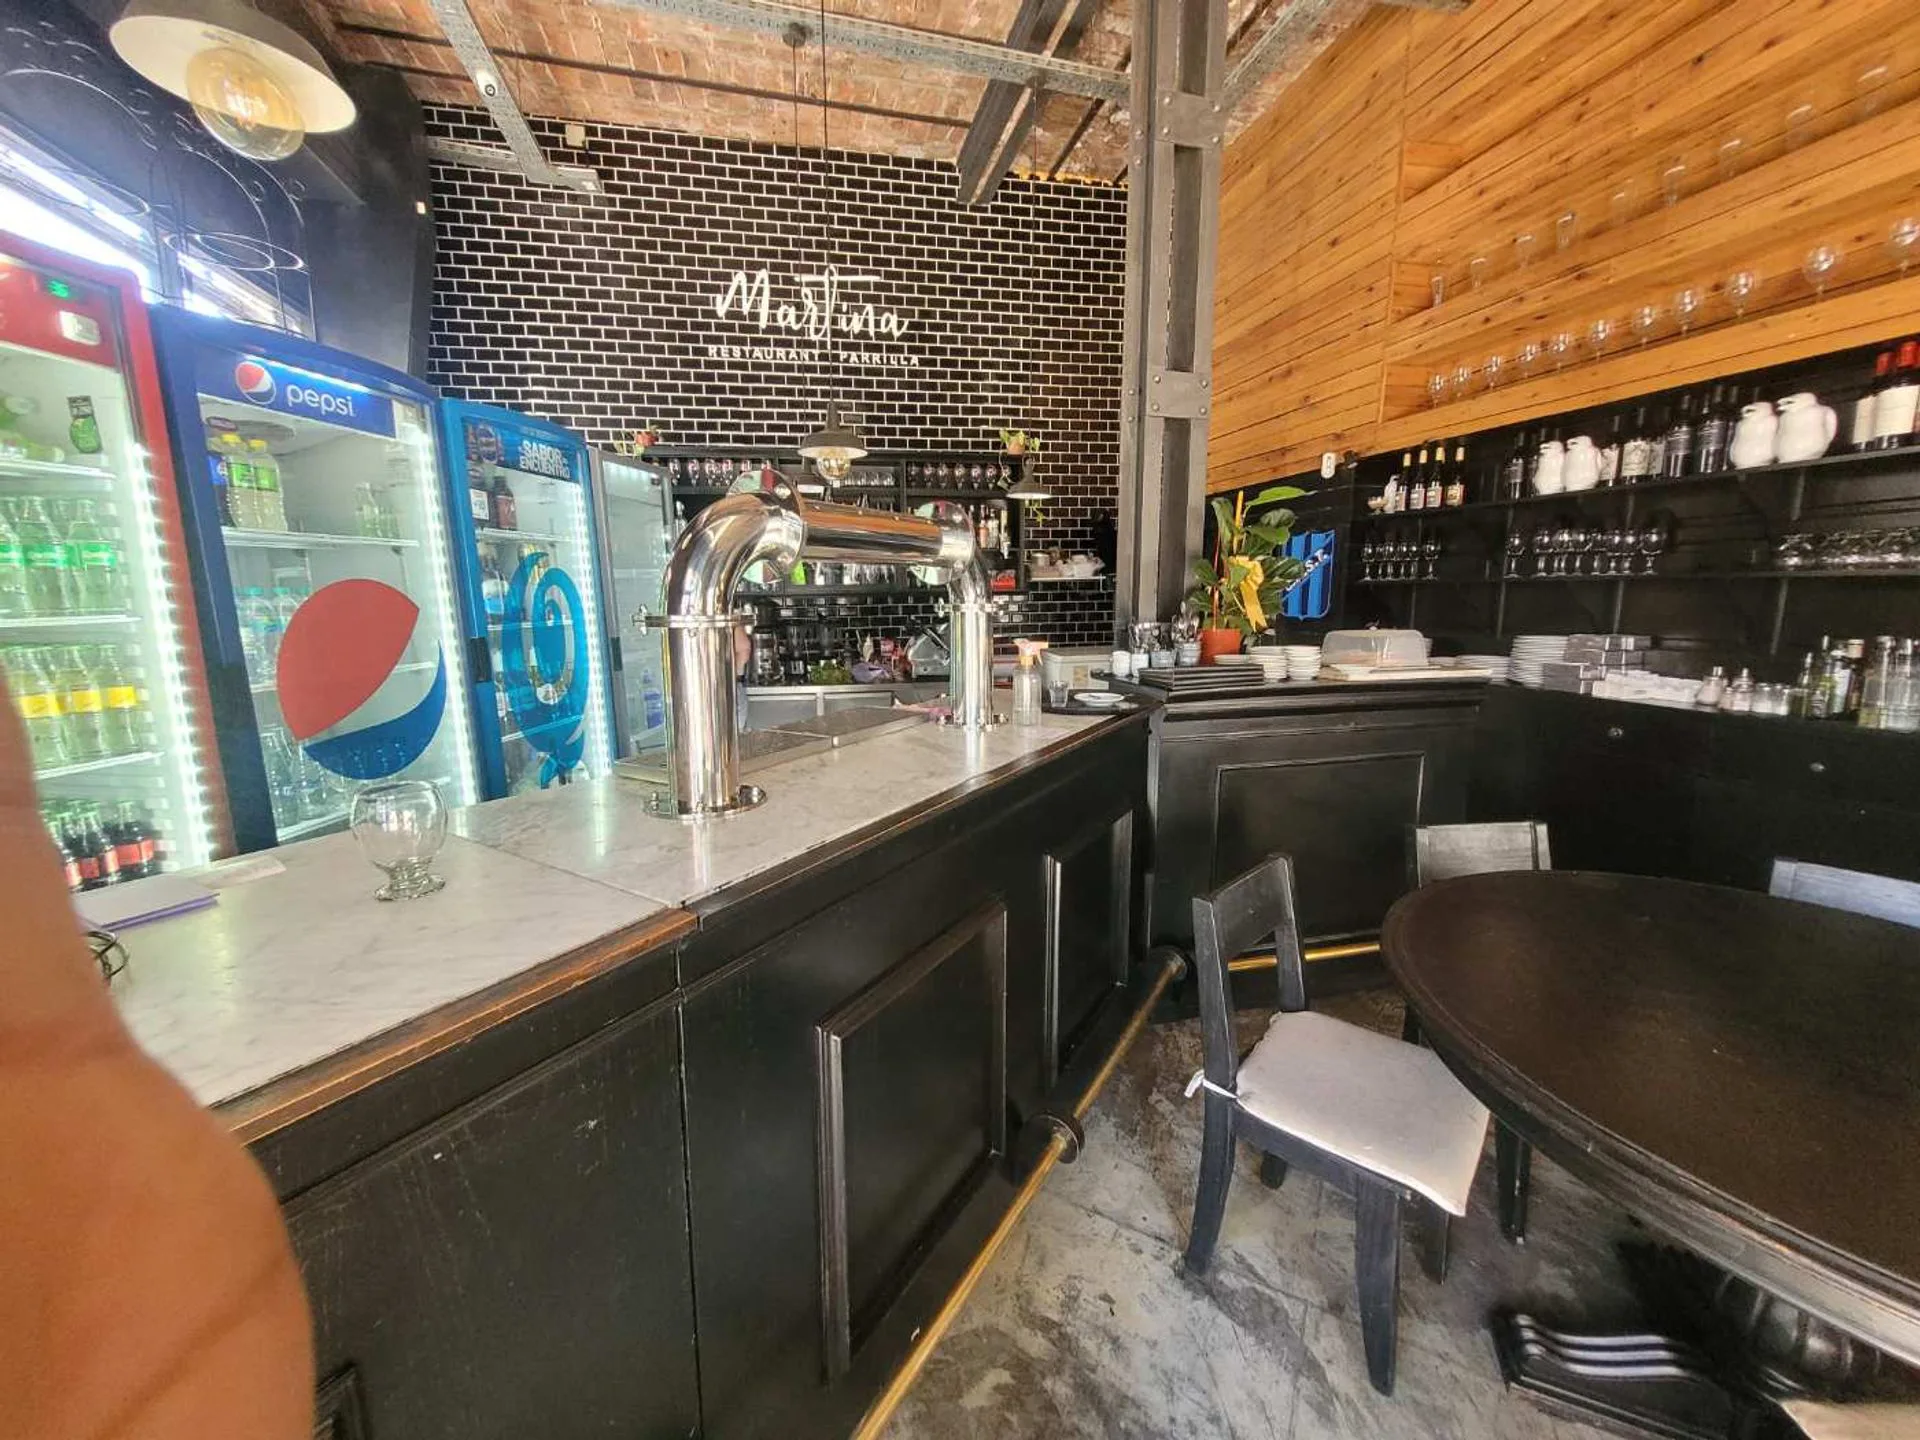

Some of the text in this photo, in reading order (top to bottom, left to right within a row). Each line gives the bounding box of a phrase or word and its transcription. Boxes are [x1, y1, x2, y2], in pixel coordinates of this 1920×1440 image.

[715, 265, 909, 349] Martina
[707, 345, 919, 366] RESTAURANT PARRILLA
[286, 384, 355, 418] pepsi
[521, 440, 562, 462] SABOR
